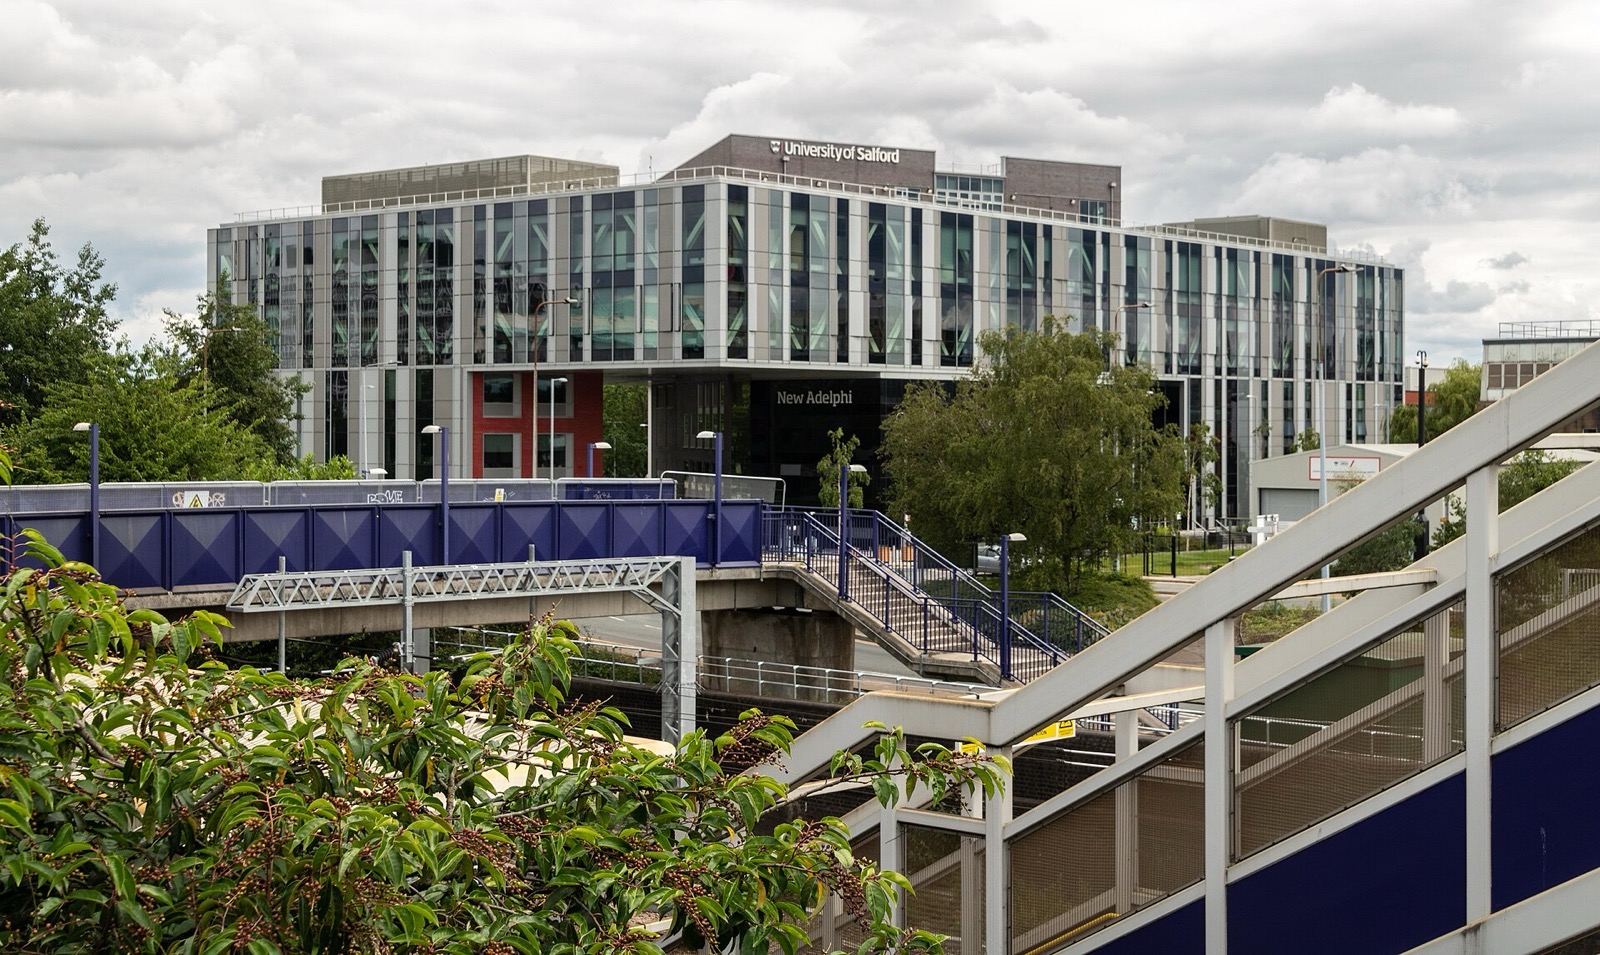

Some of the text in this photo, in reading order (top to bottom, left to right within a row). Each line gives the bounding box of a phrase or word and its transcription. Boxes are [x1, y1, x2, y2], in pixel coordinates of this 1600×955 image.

[784, 141, 900, 163] University of Salford
[777, 390, 853, 407] New Adelphi
